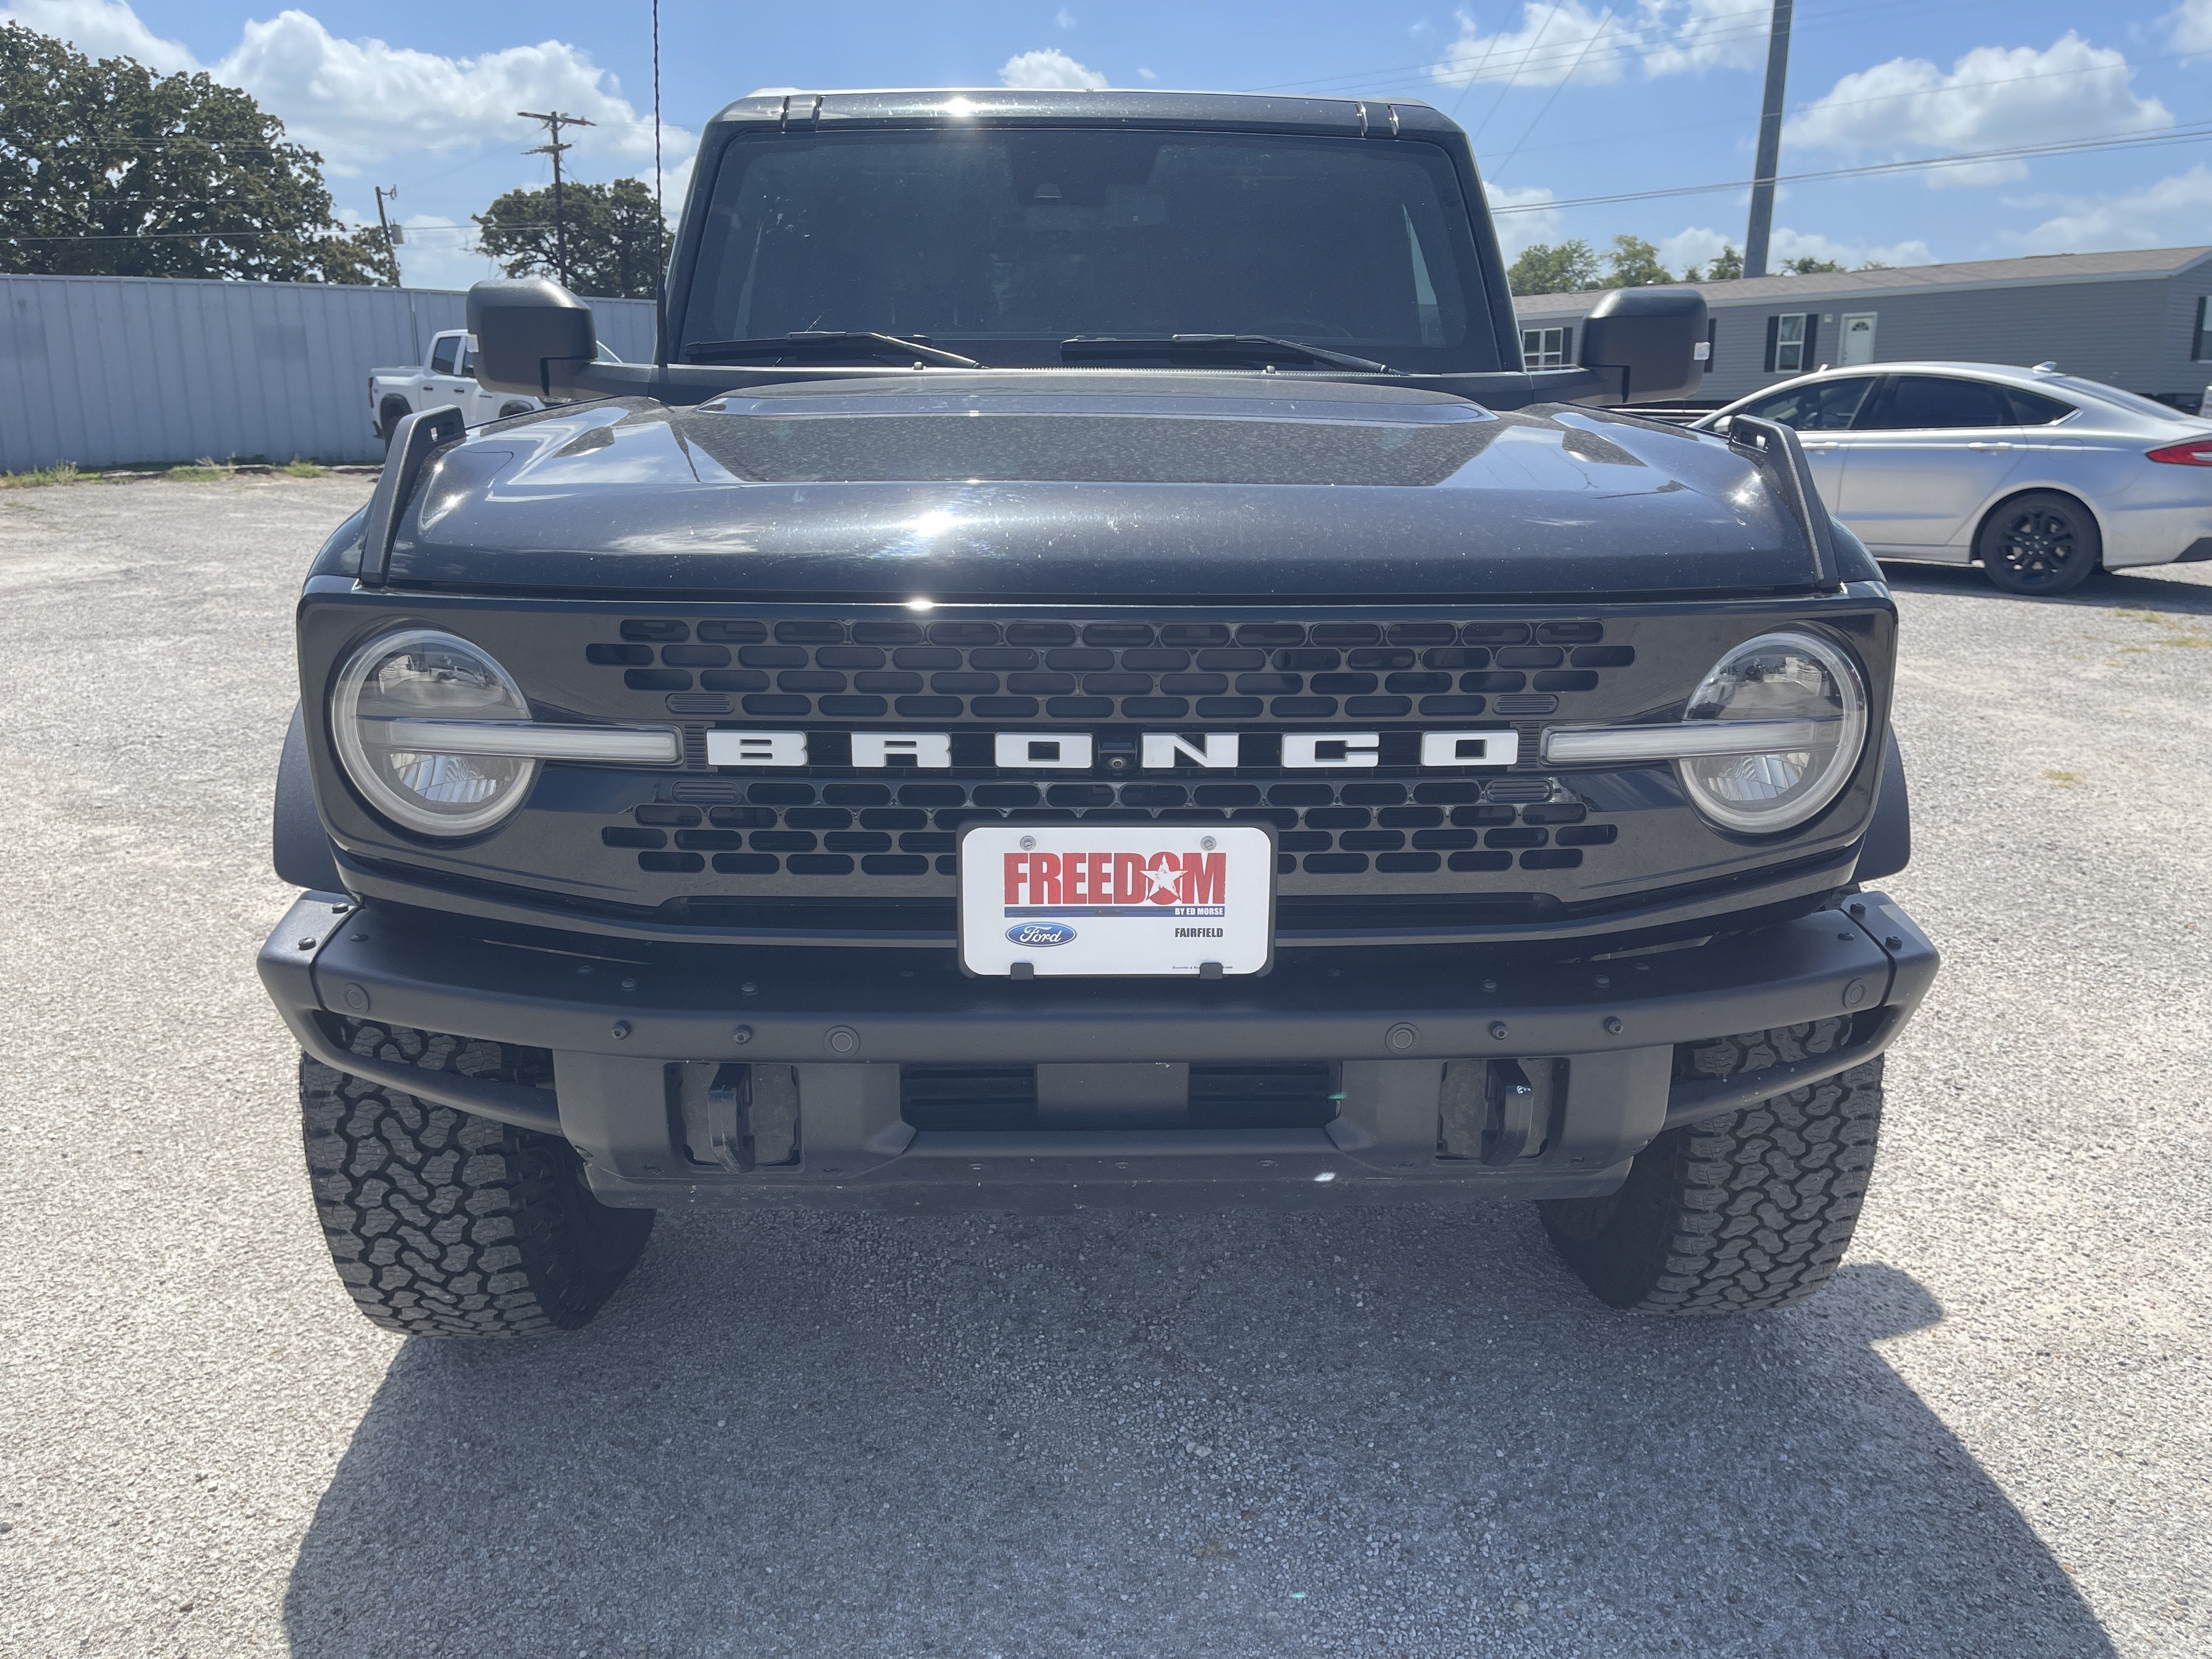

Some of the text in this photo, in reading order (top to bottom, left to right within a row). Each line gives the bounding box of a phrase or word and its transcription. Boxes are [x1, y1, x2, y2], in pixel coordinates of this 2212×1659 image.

[706, 729, 1519, 768] BRONCO
[1003, 851, 1226, 905] FREEDOM
[1019, 926, 1063, 943] Ford
[1175, 928, 1223, 938] FAIRFIELD
